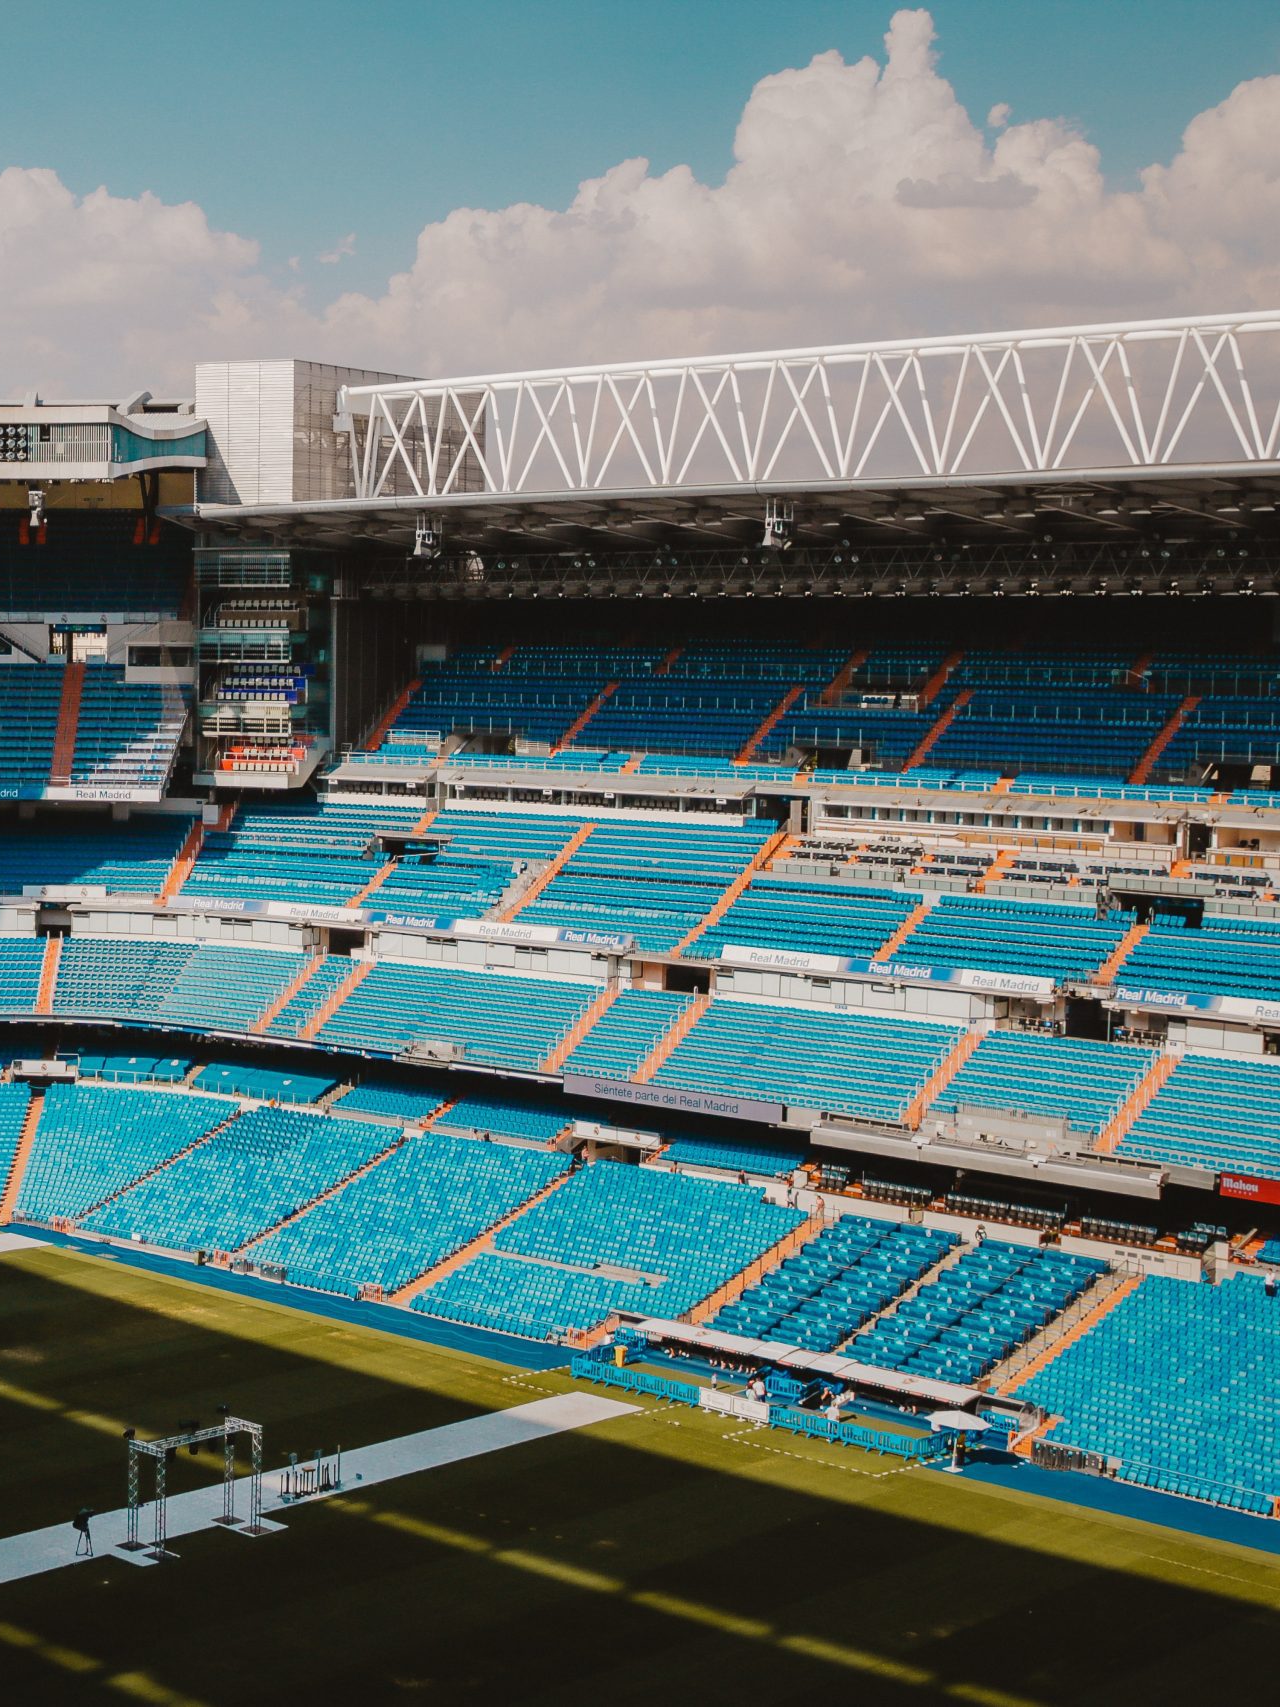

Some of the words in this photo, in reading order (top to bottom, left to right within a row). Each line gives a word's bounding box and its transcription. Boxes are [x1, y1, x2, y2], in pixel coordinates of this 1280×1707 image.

[76, 790, 96, 799] Real
[98, 789, 131, 799] Madrid
[193, 899, 212, 909] Real
[215, 900, 244, 910] Madrid
[290, 906, 309, 918] Real
[311, 907, 339, 920] Madrid
[386, 914, 405, 926] Real
[406, 915, 435, 928] Madrid
[479, 926, 500, 937] Real
[502, 926, 531, 939] Madrid
[565, 931, 585, 943] Real
[587, 932, 618, 945] Madrid
[750, 952, 771, 965] Real
[774, 954, 809, 967] Madrid
[868, 961, 892, 974] Real
[893, 963, 931, 978] Madrid
[972, 975, 996, 988] Real
[999, 977, 1039, 992] Madrid
[1116, 988, 1142, 1001] Real
[1144, 991, 1186, 1006] Madrid
[1255, 1005, 1280, 1018] Rea
[594, 1083, 633, 1100] Siéntete
[635, 1089, 661, 1104] parte
[662, 1091, 677, 1105] del
[680, 1094, 701, 1108] Real
[704, 1098, 738, 1114] Madrid
[1222, 1178, 1258, 1193] Mahou
